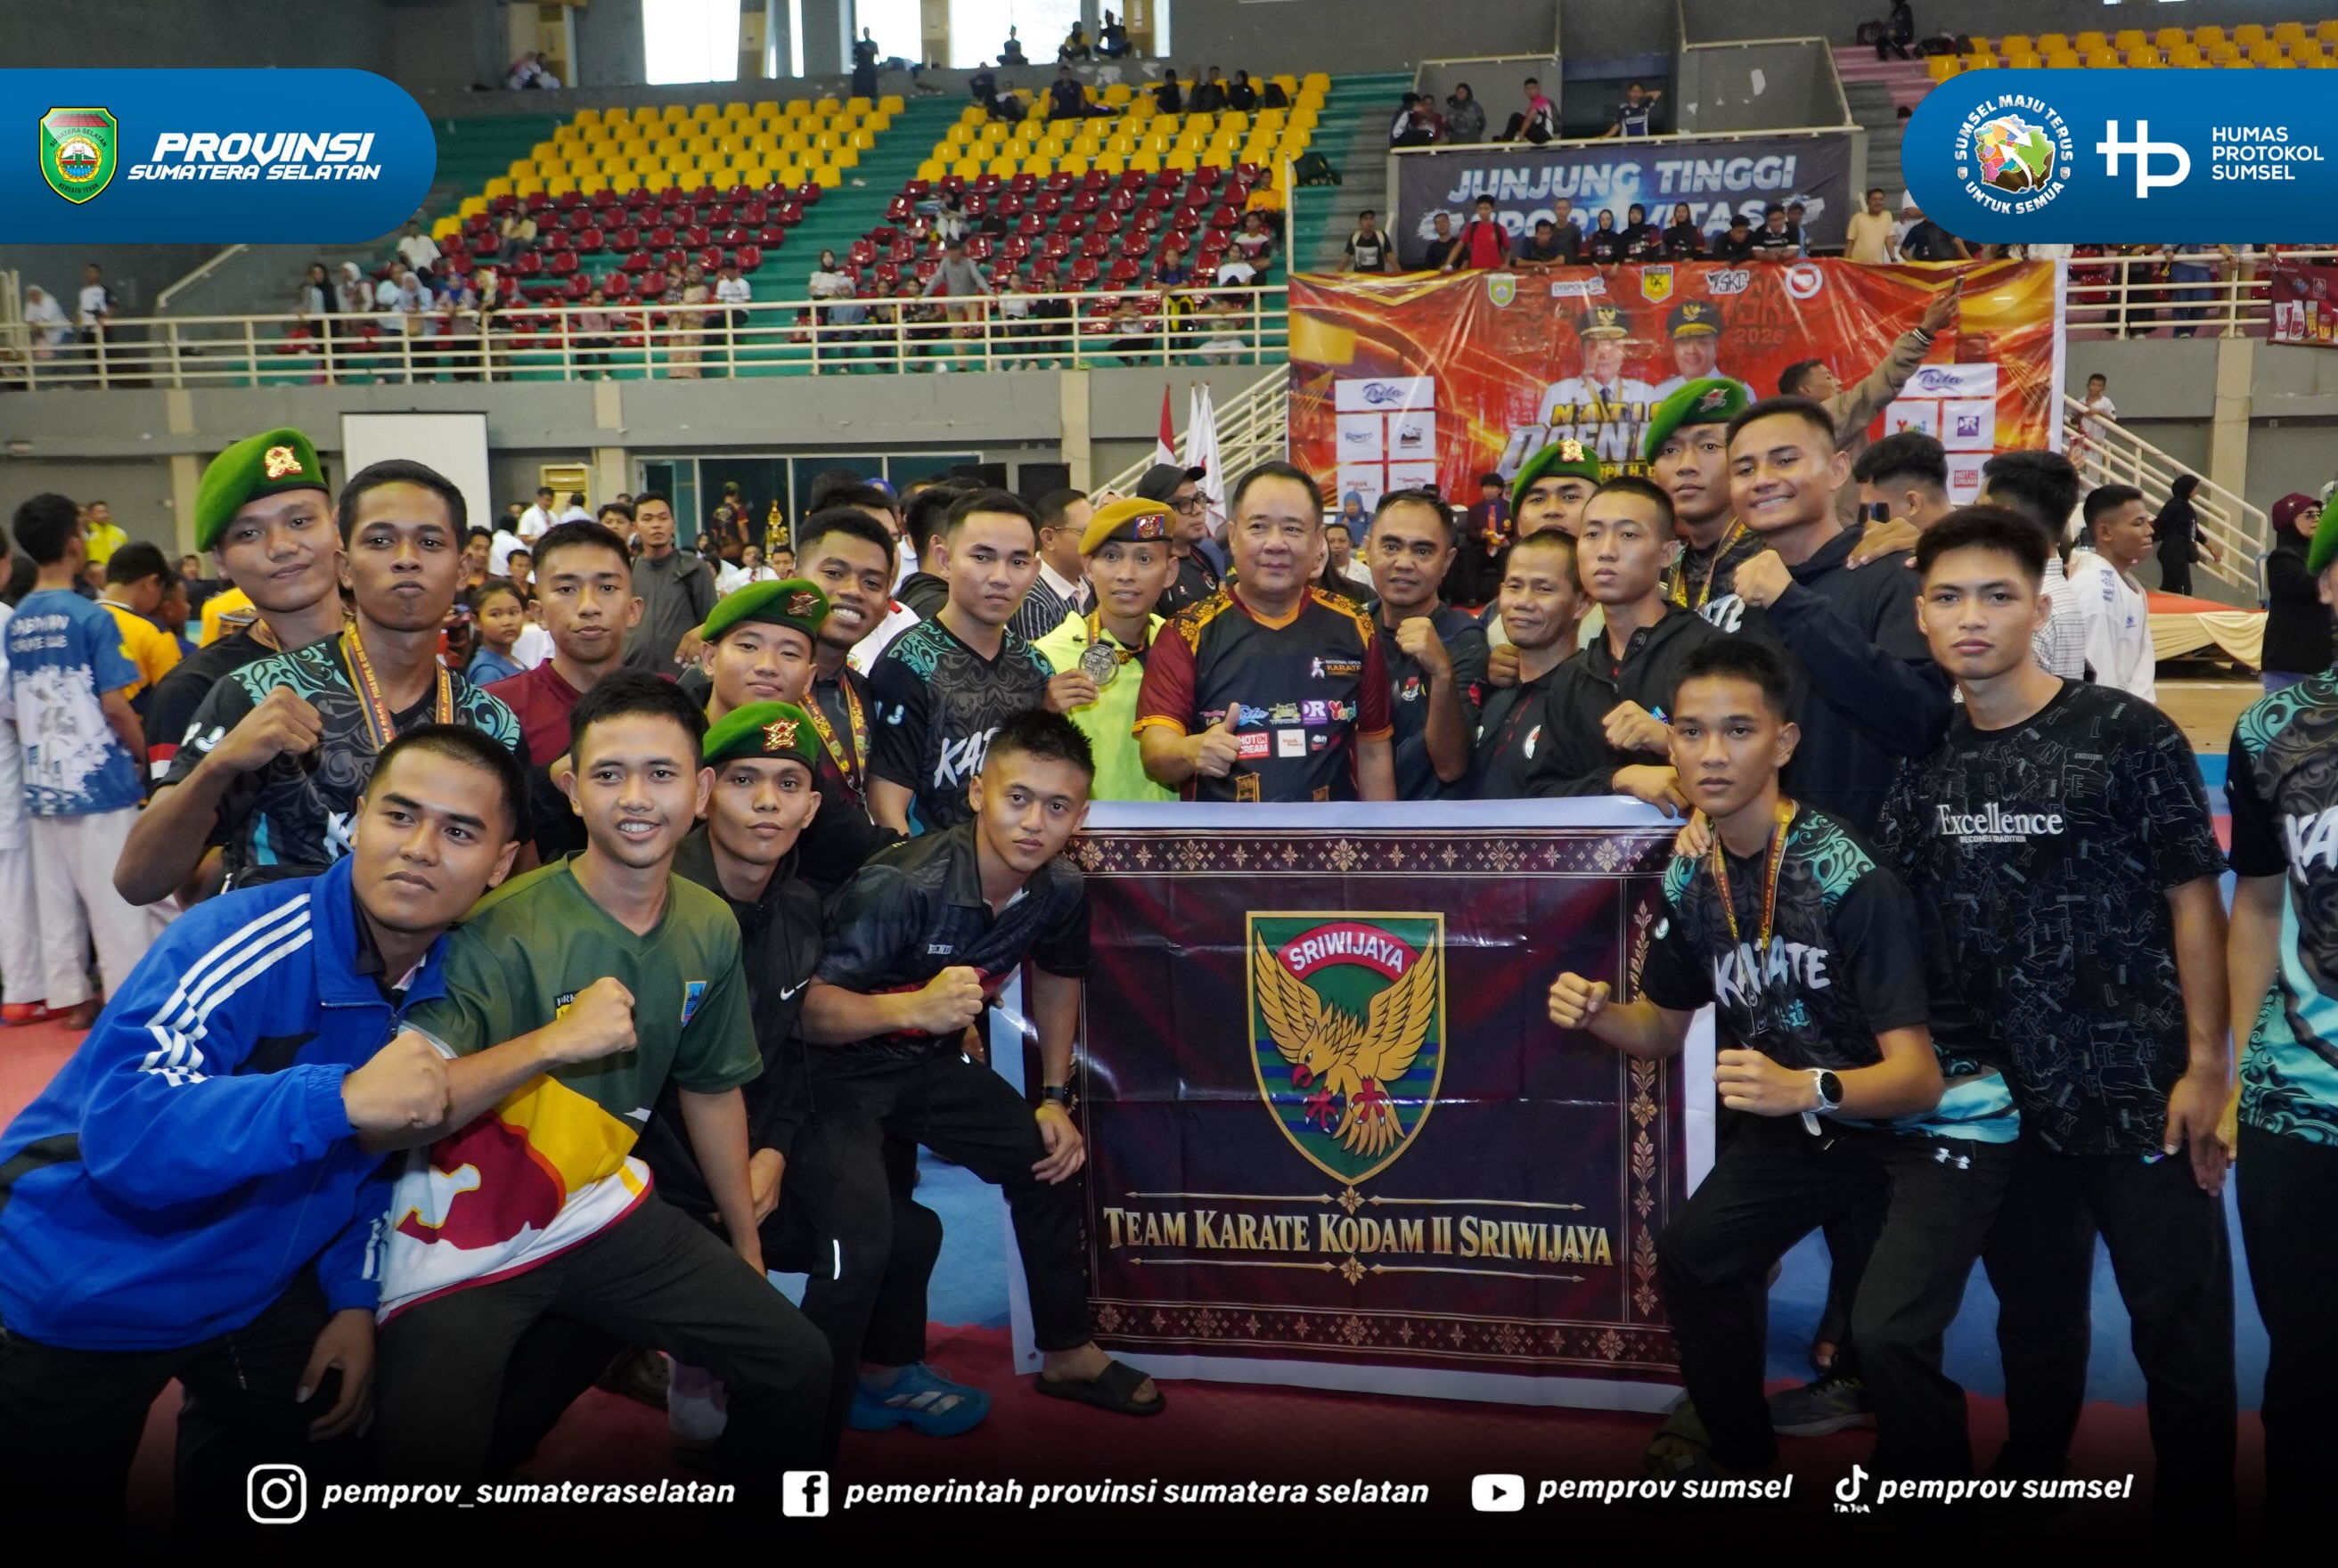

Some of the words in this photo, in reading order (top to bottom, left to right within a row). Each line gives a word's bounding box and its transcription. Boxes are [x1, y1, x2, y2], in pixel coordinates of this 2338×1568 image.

[1447, 162, 1641, 202] JUNJUNG
[1654, 155, 1797, 194] TINGGI
[1937, 802, 2064, 835] Excellence
[1288, 931, 1404, 973] SRIWIJAYA
[1103, 1207, 1187, 1249] TEAM
[1194, 1210, 1311, 1251] KARATE
[1318, 1213, 1426, 1254] KODAM
[1432, 1216, 1453, 1255] II
[1459, 1215, 1615, 1267] SRIWIJAYA
